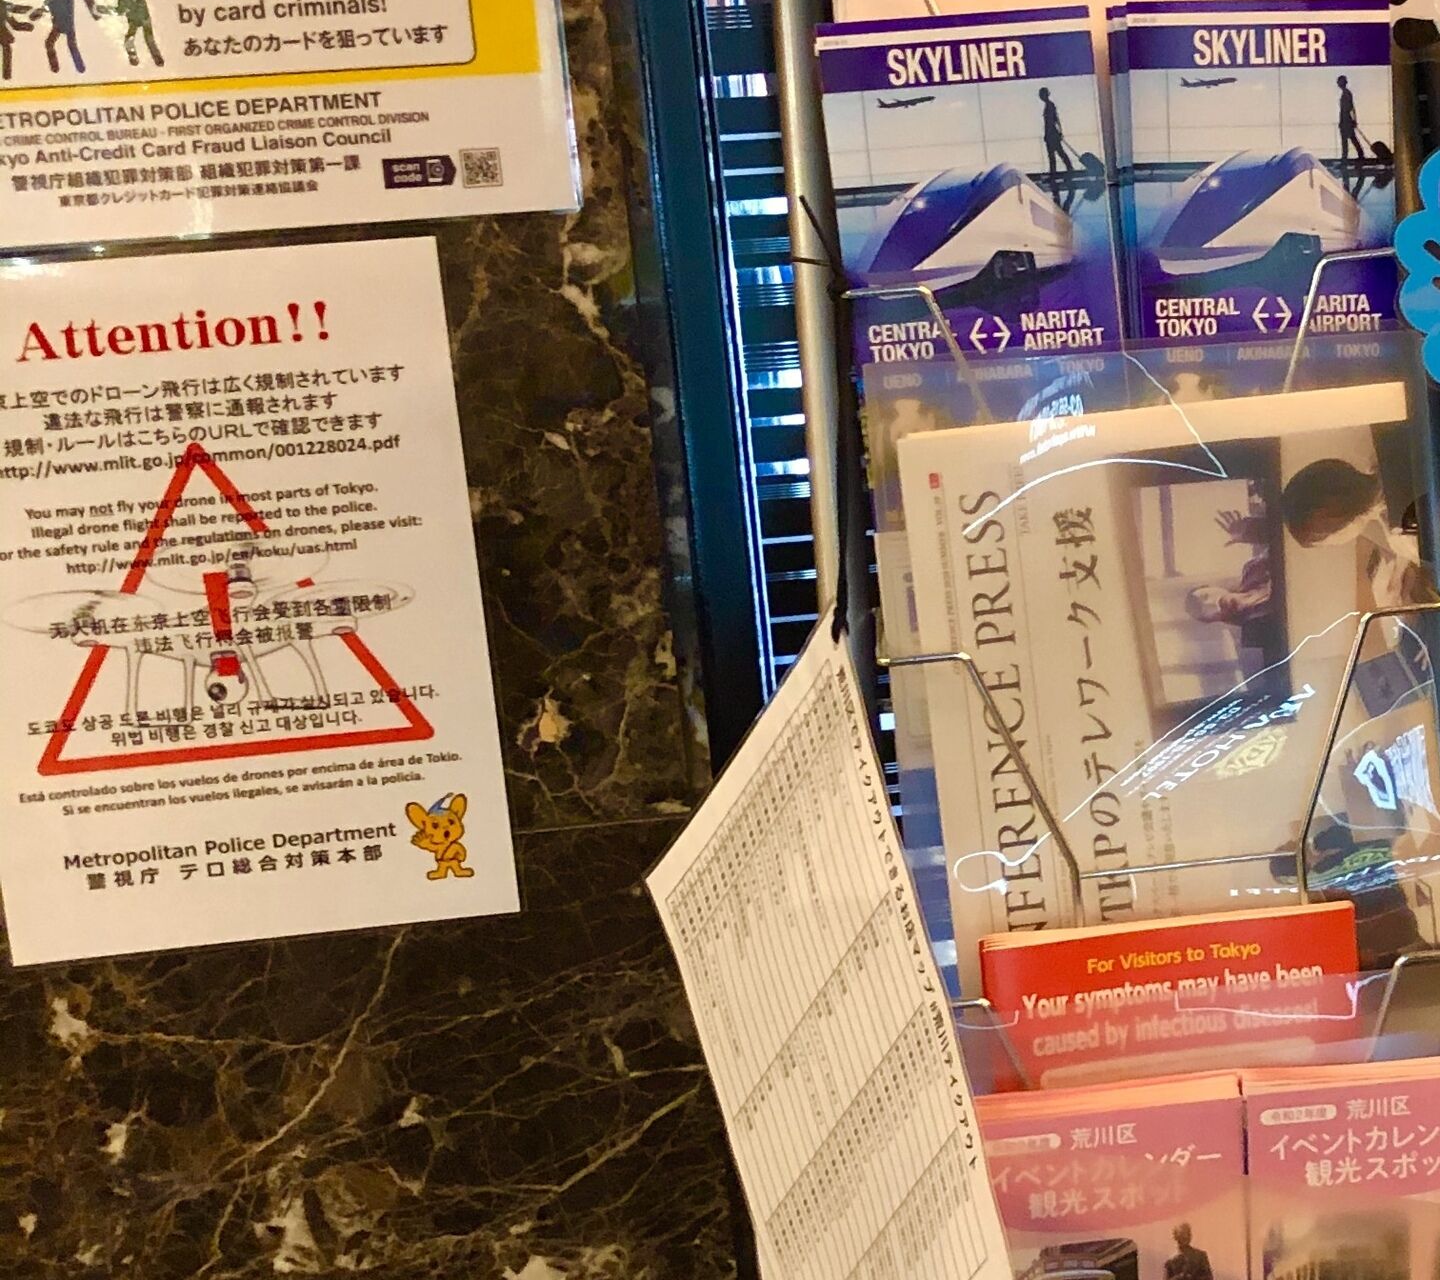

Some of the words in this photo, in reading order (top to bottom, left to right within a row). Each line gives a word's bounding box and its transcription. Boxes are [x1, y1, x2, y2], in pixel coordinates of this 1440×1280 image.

[178, 3, 206, 28] by
[214, 0, 266, 22] card
[183, 23, 449, 57] あなたのカードを狙っています
[1193, 28, 1327, 66] SKYLINER
[886, 40, 1027, 87] SKYLINER
[150, 99, 231, 121] POLICE
[235, 91, 382, 117] DEPARTMENT
[34, 146, 136, 165] Anti-Credit
[142, 140, 186, 158] Card
[192, 136, 246, 155] Fraud
[251, 134, 317, 152] Liaison
[322, 128, 392, 147] Council
[391, 161, 421, 173] scan
[393, 171, 423, 183] code
[1019, 308, 1092, 332] NARITA
[1154, 297, 1241, 318] CENTRAL
[15, 300, 330, 363] Attention!!
[869, 341, 935, 364] TOKYO
[1023, 327, 1105, 352] AIRPORT
[1155, 318, 1218, 338] TOKYO
[1335, 342, 1381, 359] TOKYO
[43, 391, 338, 431] 違法な飛行は警察に通報されます
[25, 507, 51, 520] You
[56, 505, 85, 519] may
[89, 503, 114, 517] not
[176, 494, 216, 508] drone
[276, 486, 312, 502] parts
[332, 482, 379, 496] Tokyo.
[77, 520, 120, 535] drone
[304, 502, 328, 516] the
[331, 500, 378, 516] police.
[17, 546, 41, 560] the
[45, 543, 88, 558] safety
[91, 539, 120, 553] rule
[340, 518, 386, 534] please
[63, 843, 198, 870] Metropolitan
[204, 835, 266, 857] Police
[271, 822, 397, 849] Department
[179, 844, 383, 881] テロ総合対策本部
[1086, 958, 1113, 974] For
[1119, 949, 1182, 970] Visitors
[1186, 946, 1205, 961] to
[1209, 942, 1262, 961] Tokyo
[1021, 993, 1070, 1019] Your
[1074, 980, 1173, 1015] symptoms
[1178, 972, 1220, 1002] may
[1224, 967, 1271, 989] have
[1275, 963, 1324, 988] been
[1032, 1027, 1100, 1057] caused
[1104, 1021, 1129, 1046] by
[1135, 1010, 1227, 1041] infectious
[1346, 1095, 1411, 1120] 荒川区
[1069, 1123, 1138, 1151] 荒川区
